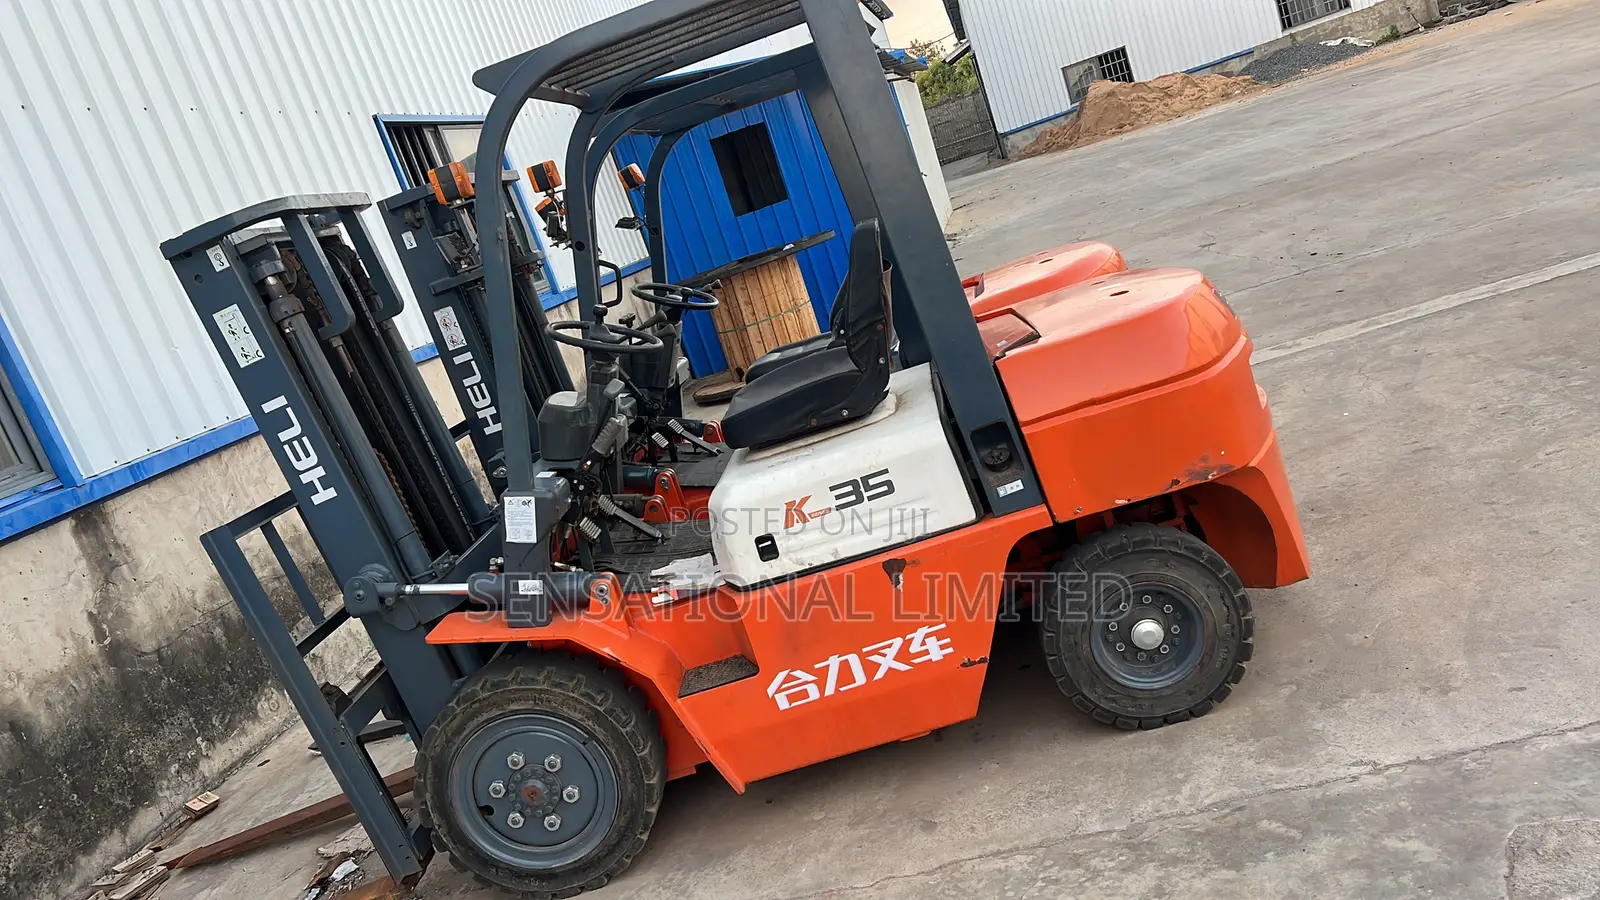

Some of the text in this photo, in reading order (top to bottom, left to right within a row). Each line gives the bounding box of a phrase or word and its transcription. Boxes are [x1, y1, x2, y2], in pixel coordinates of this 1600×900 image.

[452, 351, 503, 435] HELI
[261, 395, 338, 505] HELI
[783, 467, 896, 530] K 35
[766, 623, 955, 711] 合力叉车
